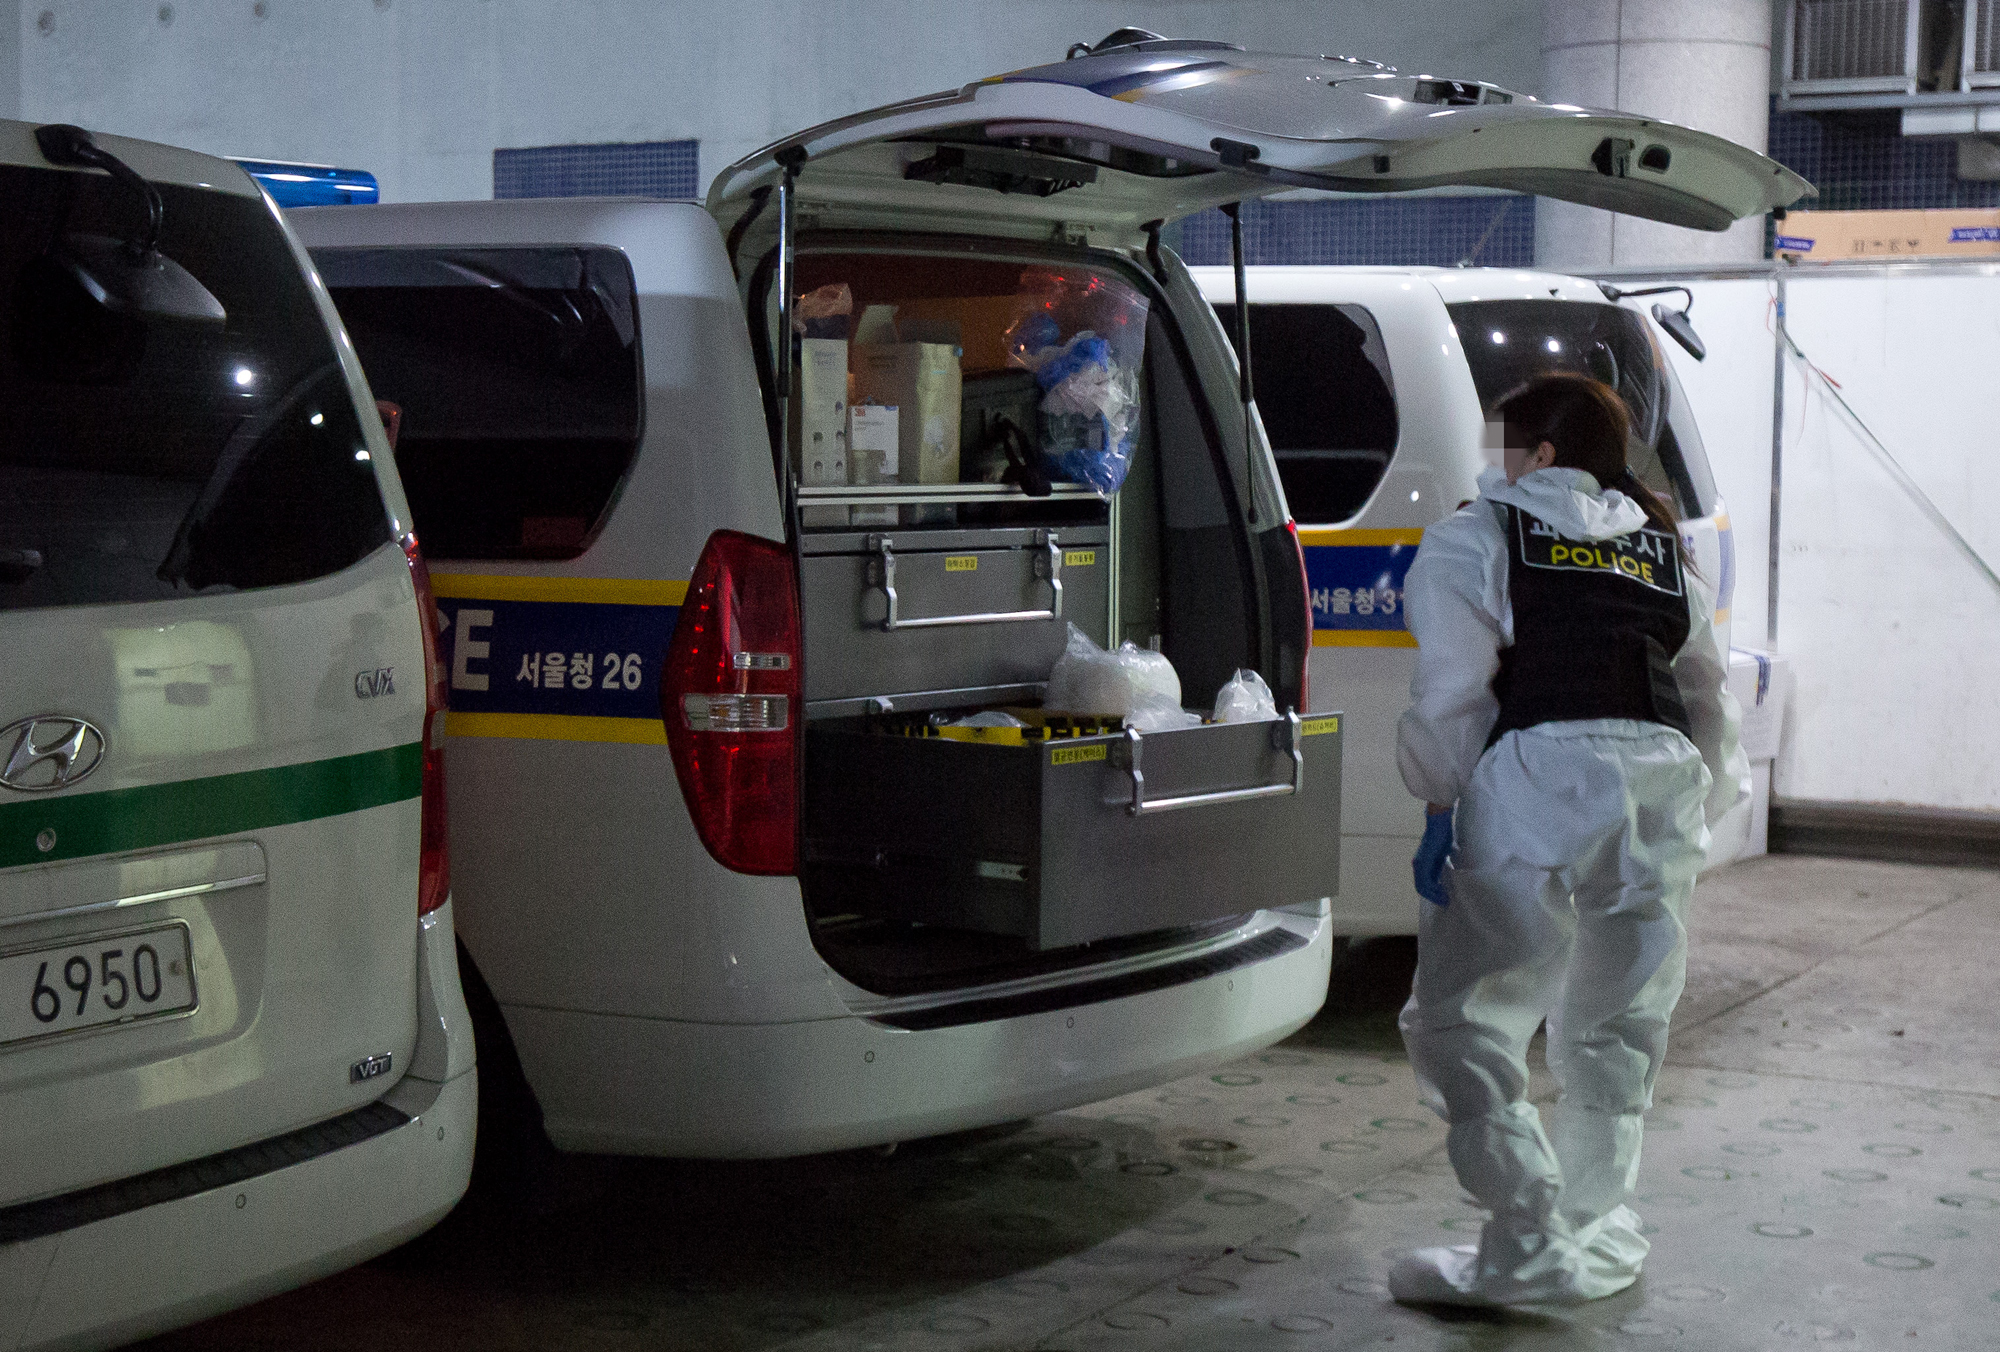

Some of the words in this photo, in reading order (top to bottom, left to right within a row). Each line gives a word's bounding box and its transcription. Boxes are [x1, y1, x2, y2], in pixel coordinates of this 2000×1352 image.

[1550, 544, 1655, 585] POLICE
[1311, 587, 1375, 615] 서울청
[1381, 588, 1405, 615] 3
[437, 608, 494, 691] E
[355, 667, 395, 699] CVX
[516, 652, 594, 690] 서울청
[602, 652, 643, 690] 26
[31, 943, 163, 1022] 6950
[359, 1057, 389, 1078] VGT
